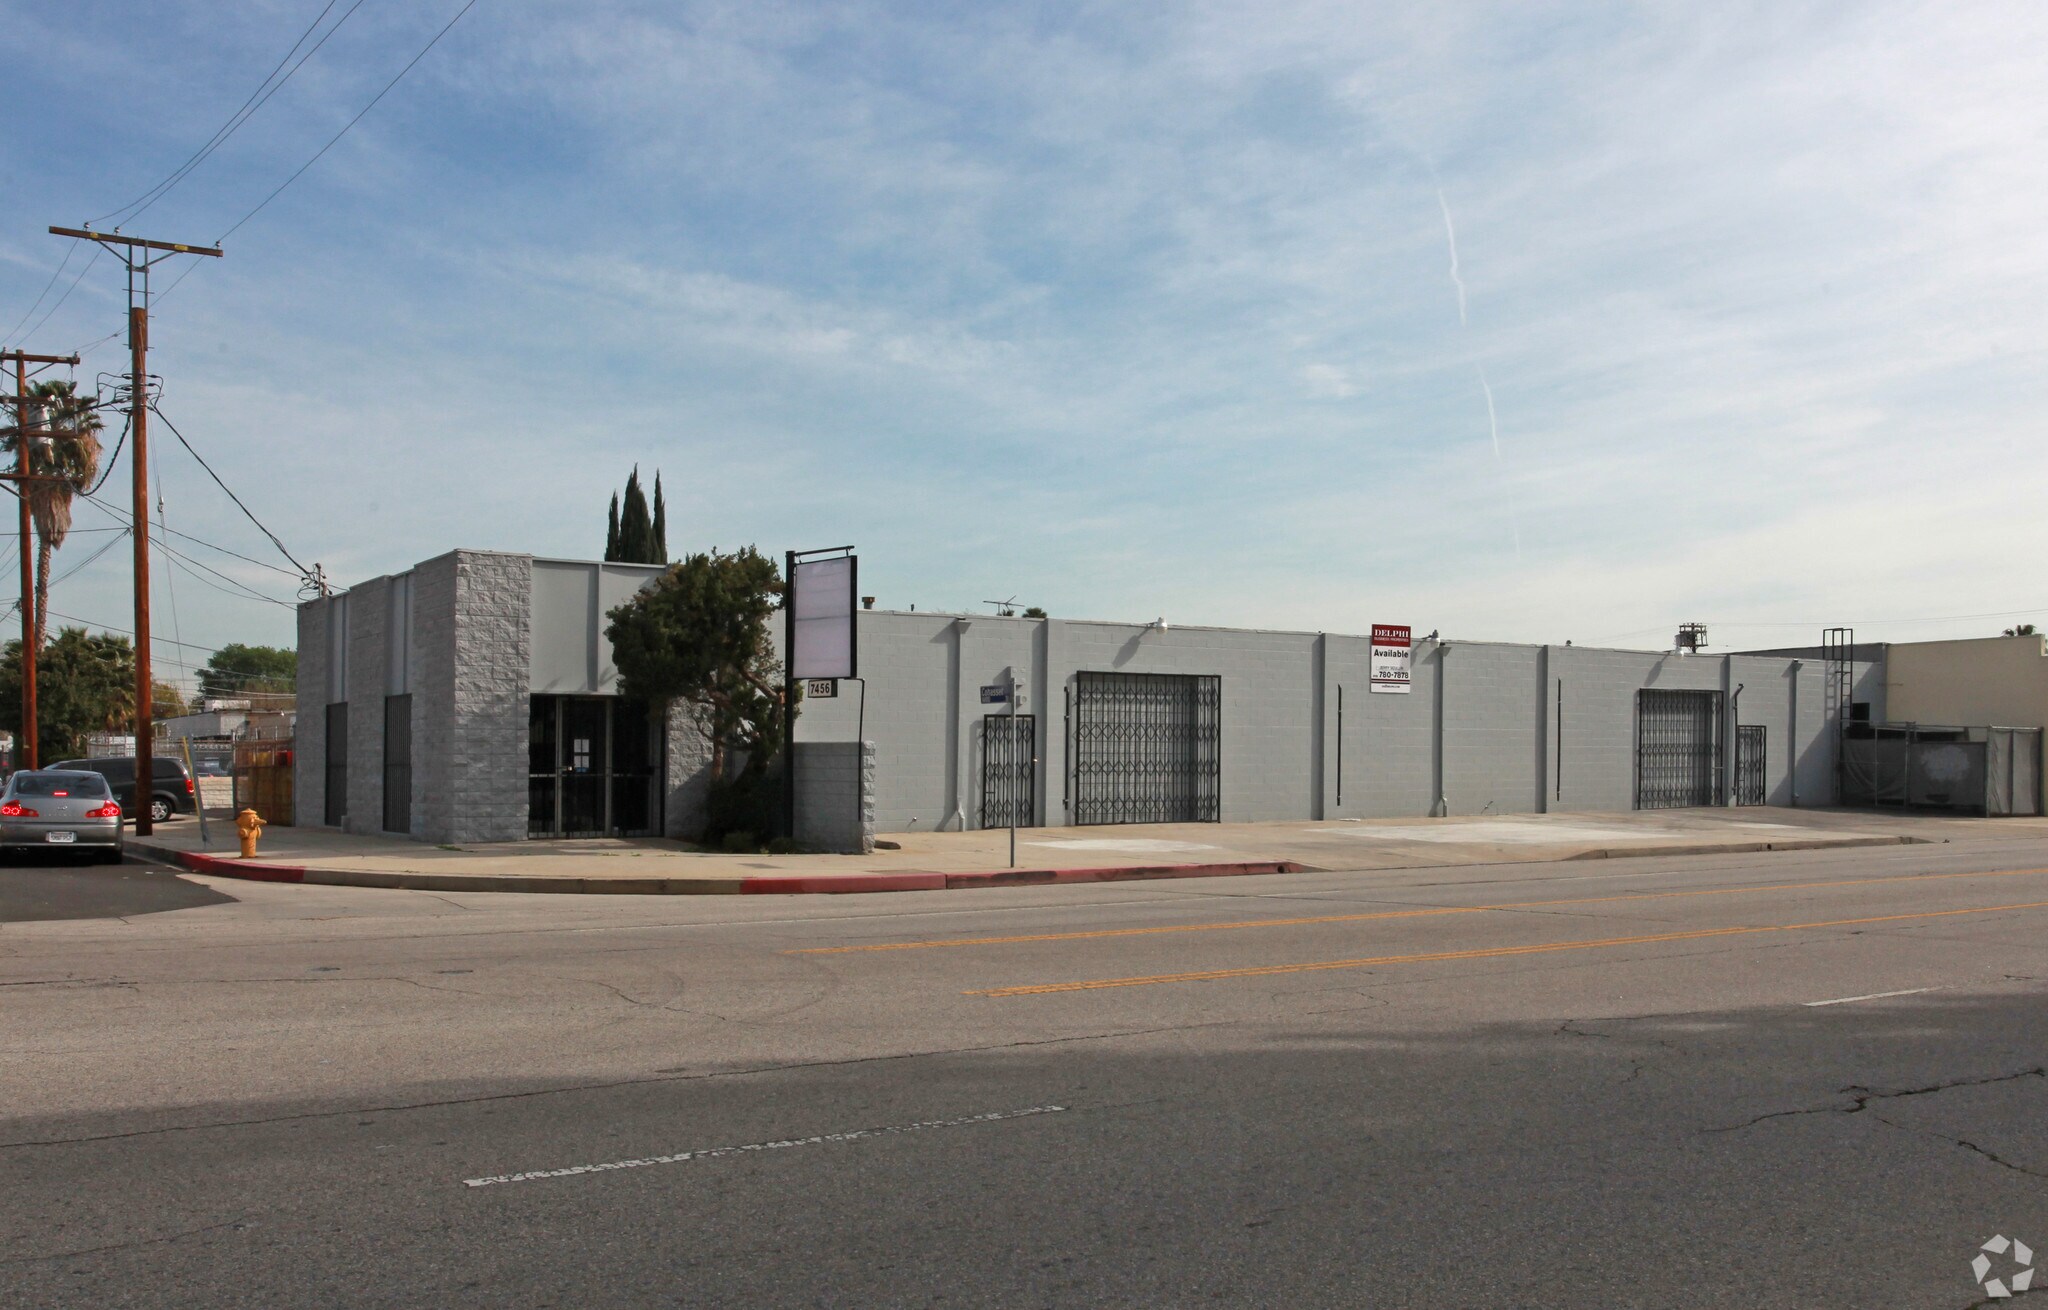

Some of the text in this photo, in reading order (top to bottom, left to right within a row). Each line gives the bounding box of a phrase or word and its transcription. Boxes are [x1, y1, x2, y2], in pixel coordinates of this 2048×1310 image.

[1374, 629, 1409, 638] DELPHI
[1374, 649, 1409, 658] Available
[810, 683, 830, 694] 7456
